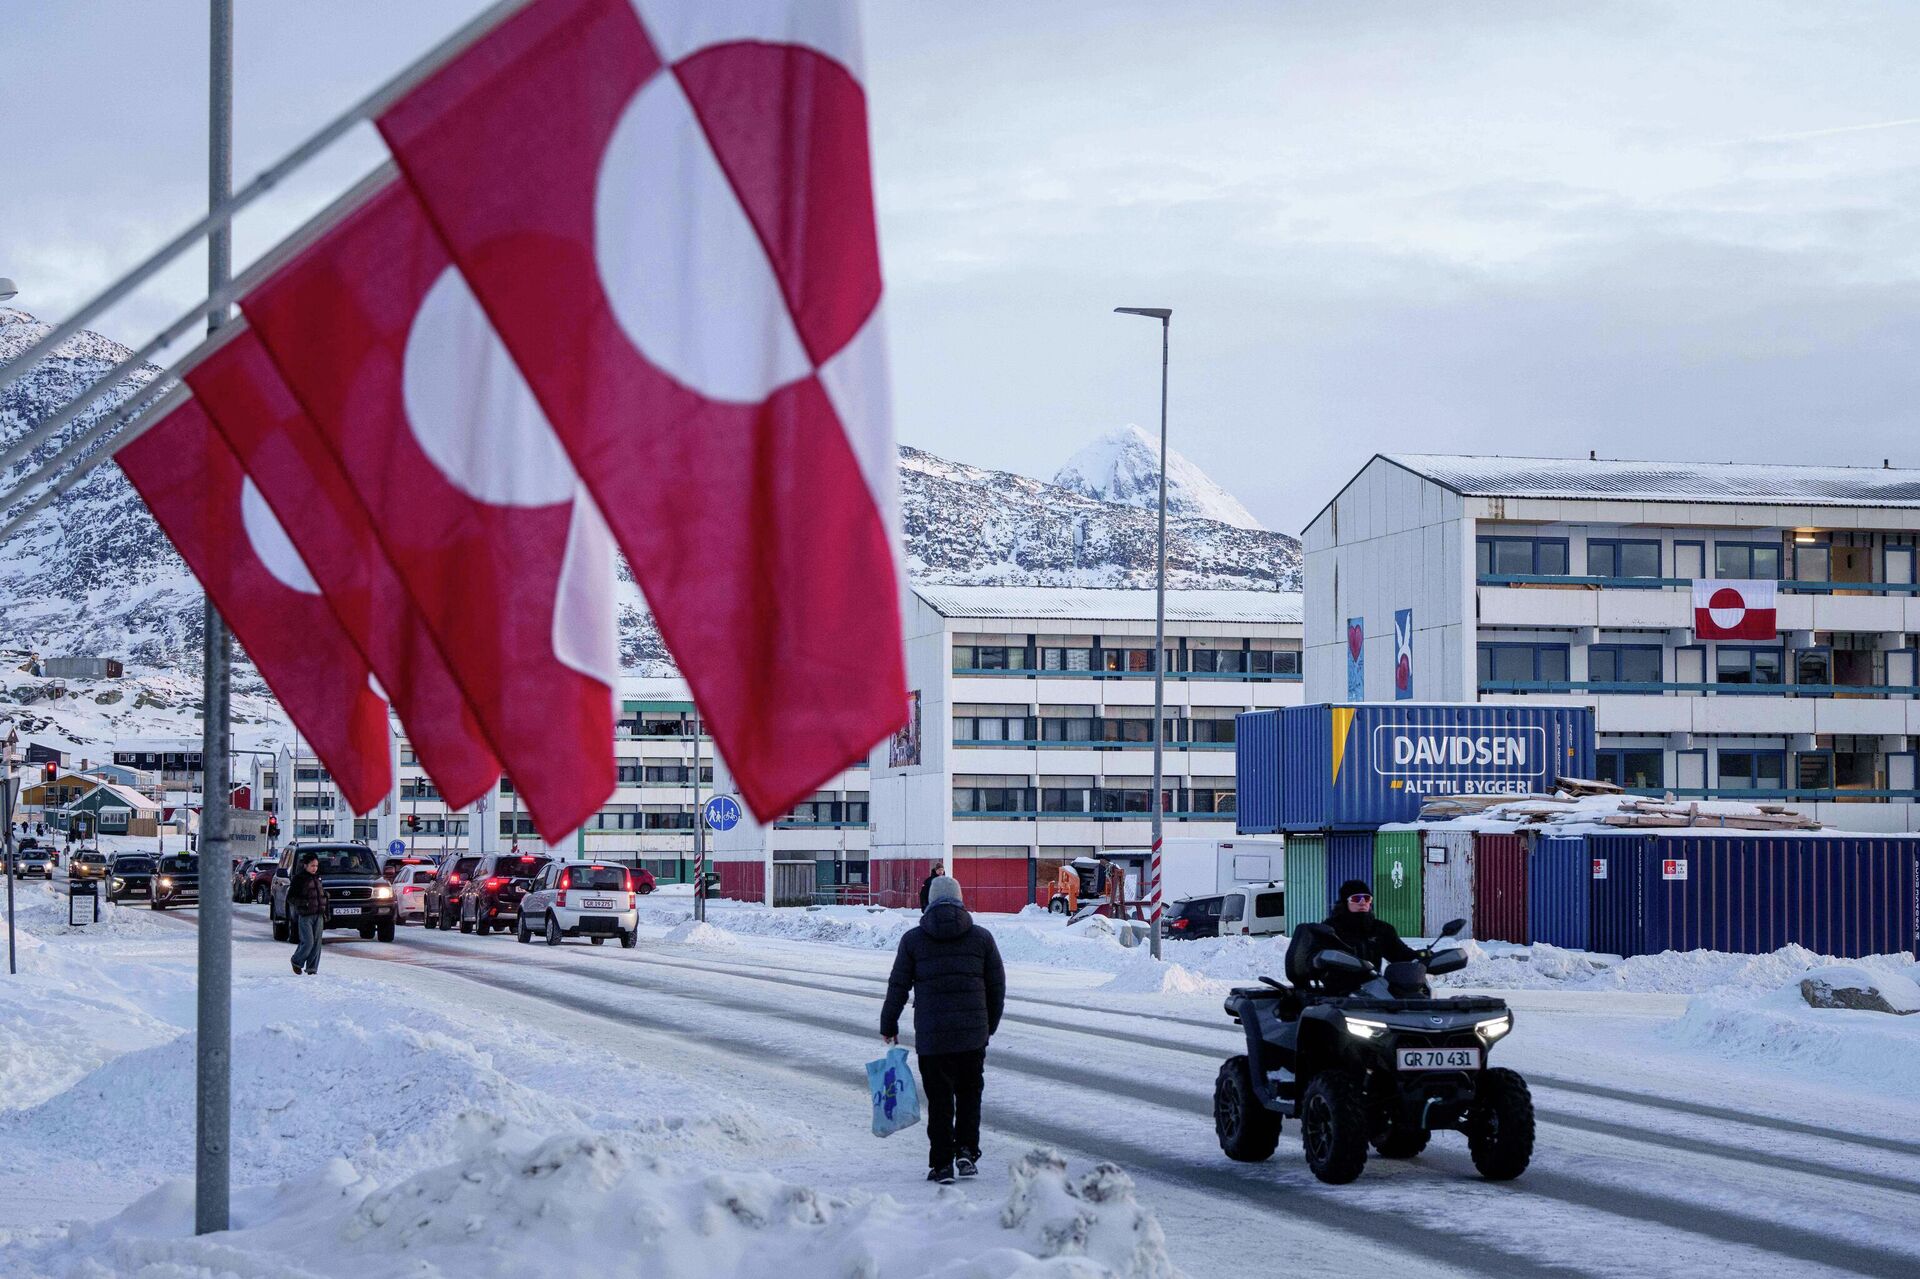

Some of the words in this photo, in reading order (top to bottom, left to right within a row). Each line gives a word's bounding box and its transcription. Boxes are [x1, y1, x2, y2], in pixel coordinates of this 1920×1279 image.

[1394, 736, 1526, 765] DAVIDSEN
[1404, 780, 1433, 794] ALT
[1435, 781, 1460, 794] TIL
[1464, 781, 1532, 794] BYGGERI
[1404, 1052, 1422, 1066] GR
[1426, 1052, 1444, 1066] 70
[1447, 1052, 1471, 1066] 431
